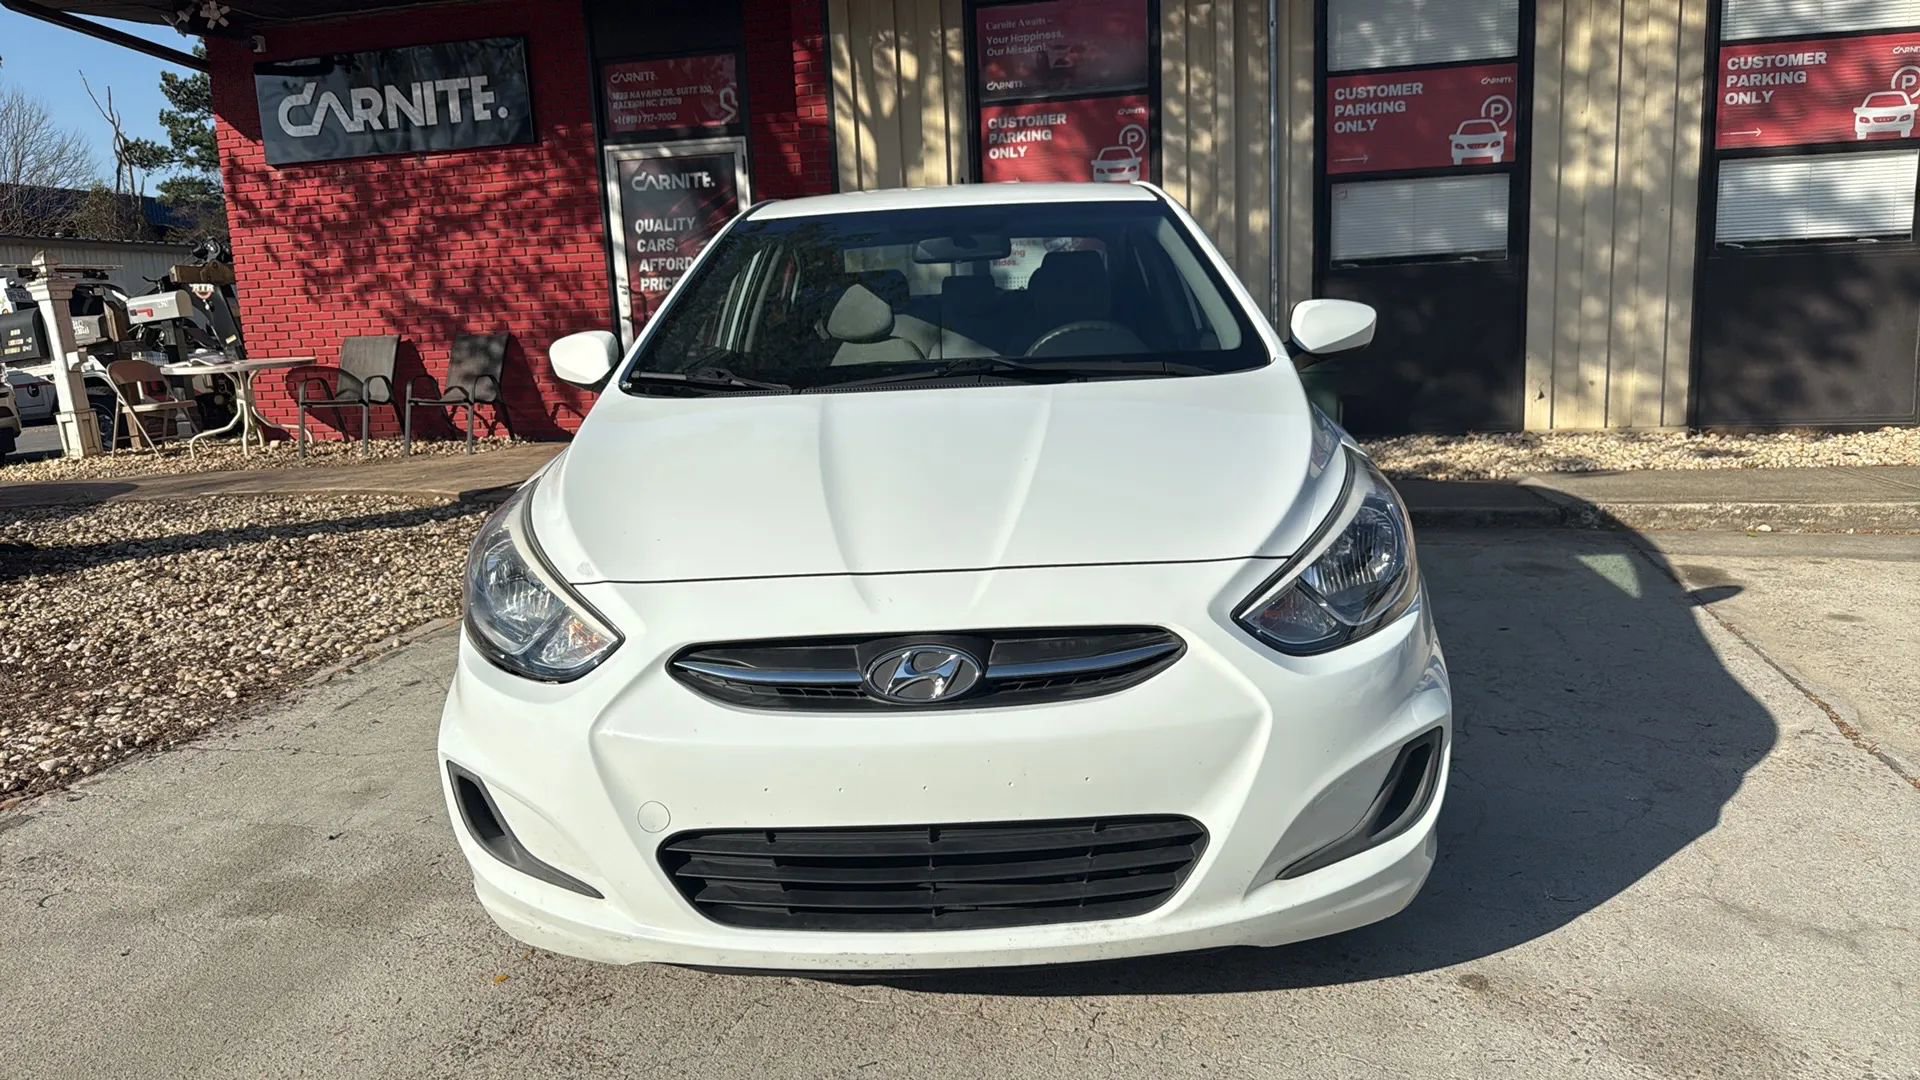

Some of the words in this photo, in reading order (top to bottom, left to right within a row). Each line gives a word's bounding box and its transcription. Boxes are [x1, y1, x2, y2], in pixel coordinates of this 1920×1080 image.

[986, 35, 1008, 45] Your
[986, 47, 1005, 57] Our
[1727, 52, 1827, 71] CUSTOMER
[1726, 71, 1807, 88] PARKING
[1334, 82, 1423, 100] CUSTOMER
[1724, 90, 1775, 106] ONLY
[1334, 100, 1406, 118] PARKING
[988, 113, 1067, 130] CUSTOMER
[1334, 118, 1377, 134] ONLY
[989, 129, 1052, 145] PARKING
[989, 146, 1028, 160] ONLY
[635, 216, 696, 234] QUALITY
[637, 238, 679, 253] CARS,
[639, 256, 694, 272] AFFORD
